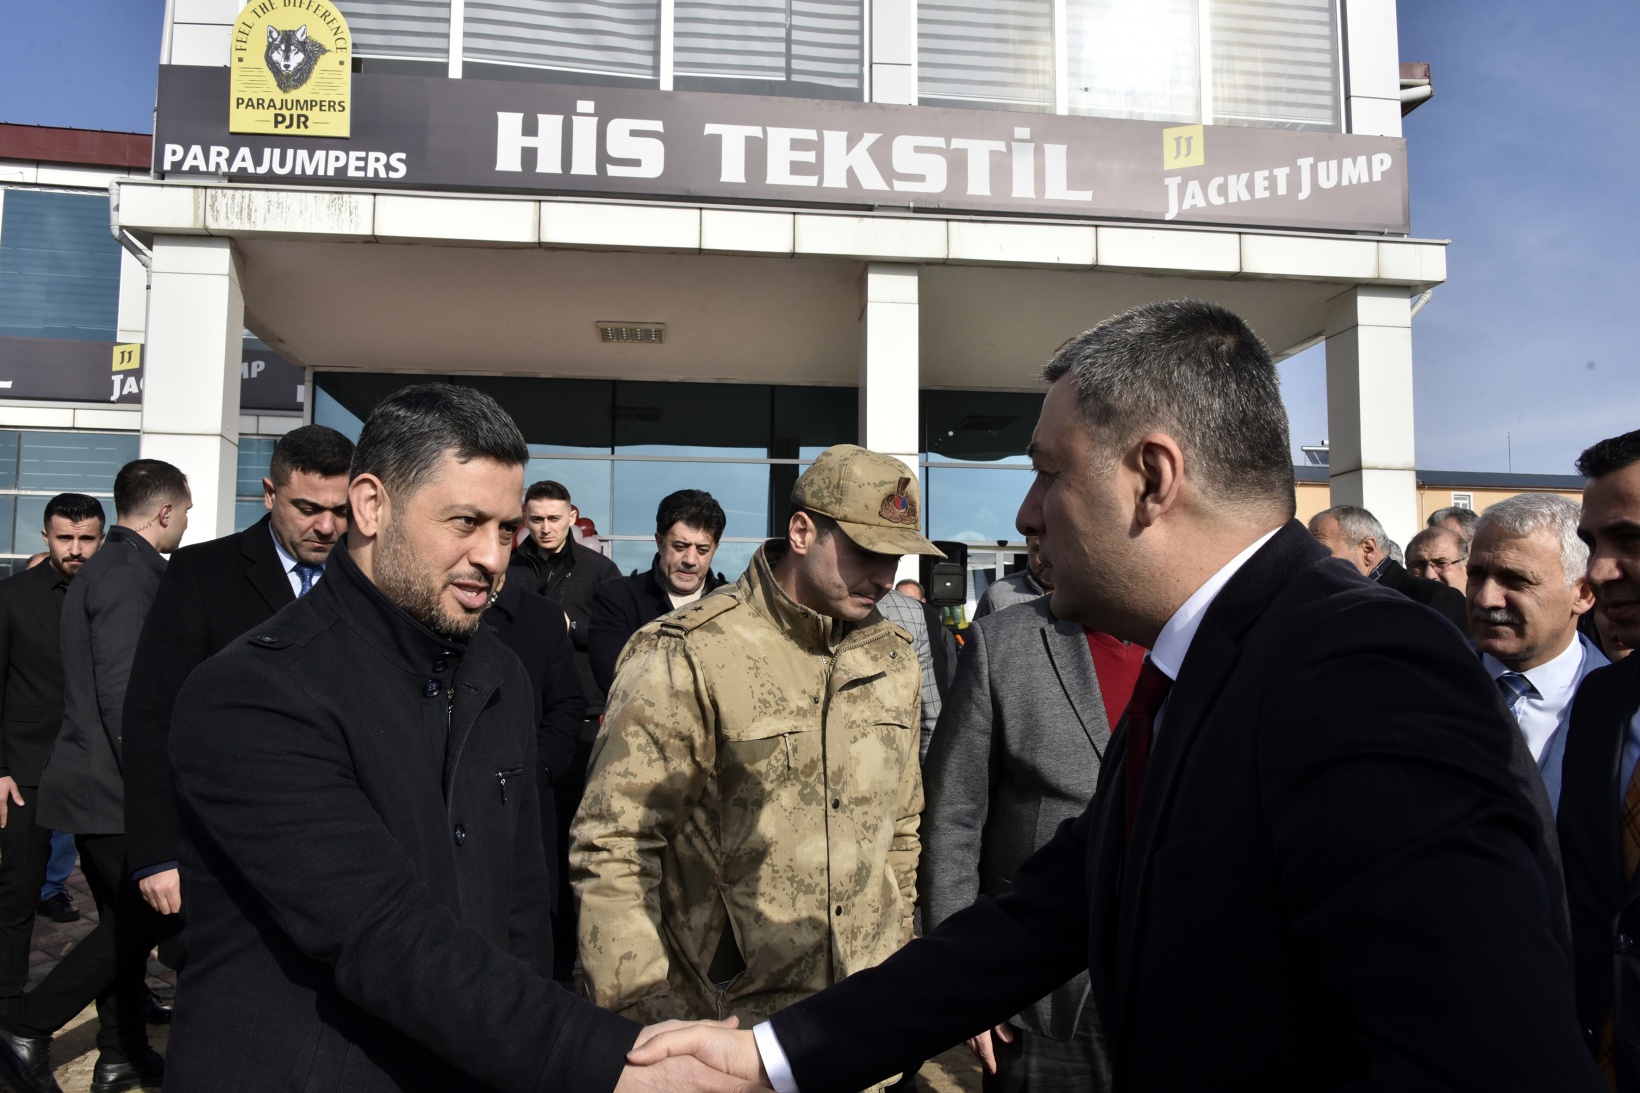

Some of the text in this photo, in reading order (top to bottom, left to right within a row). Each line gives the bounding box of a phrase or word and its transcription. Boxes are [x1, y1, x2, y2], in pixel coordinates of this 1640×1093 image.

[235, 0, 348, 53] FEEL THE DIFFERENCE
[236, 97, 346, 112] PARAJUMPERS
[273, 113, 310, 130] PJR
[163, 143, 407, 179] PARAJUMPERS
[495, 100, 1094, 201] HİS TEKSTİL
[1173, 135, 1194, 160] JJ
[1164, 152, 1392, 221] JACKET JUMP
[119, 350, 133, 365] JJ
